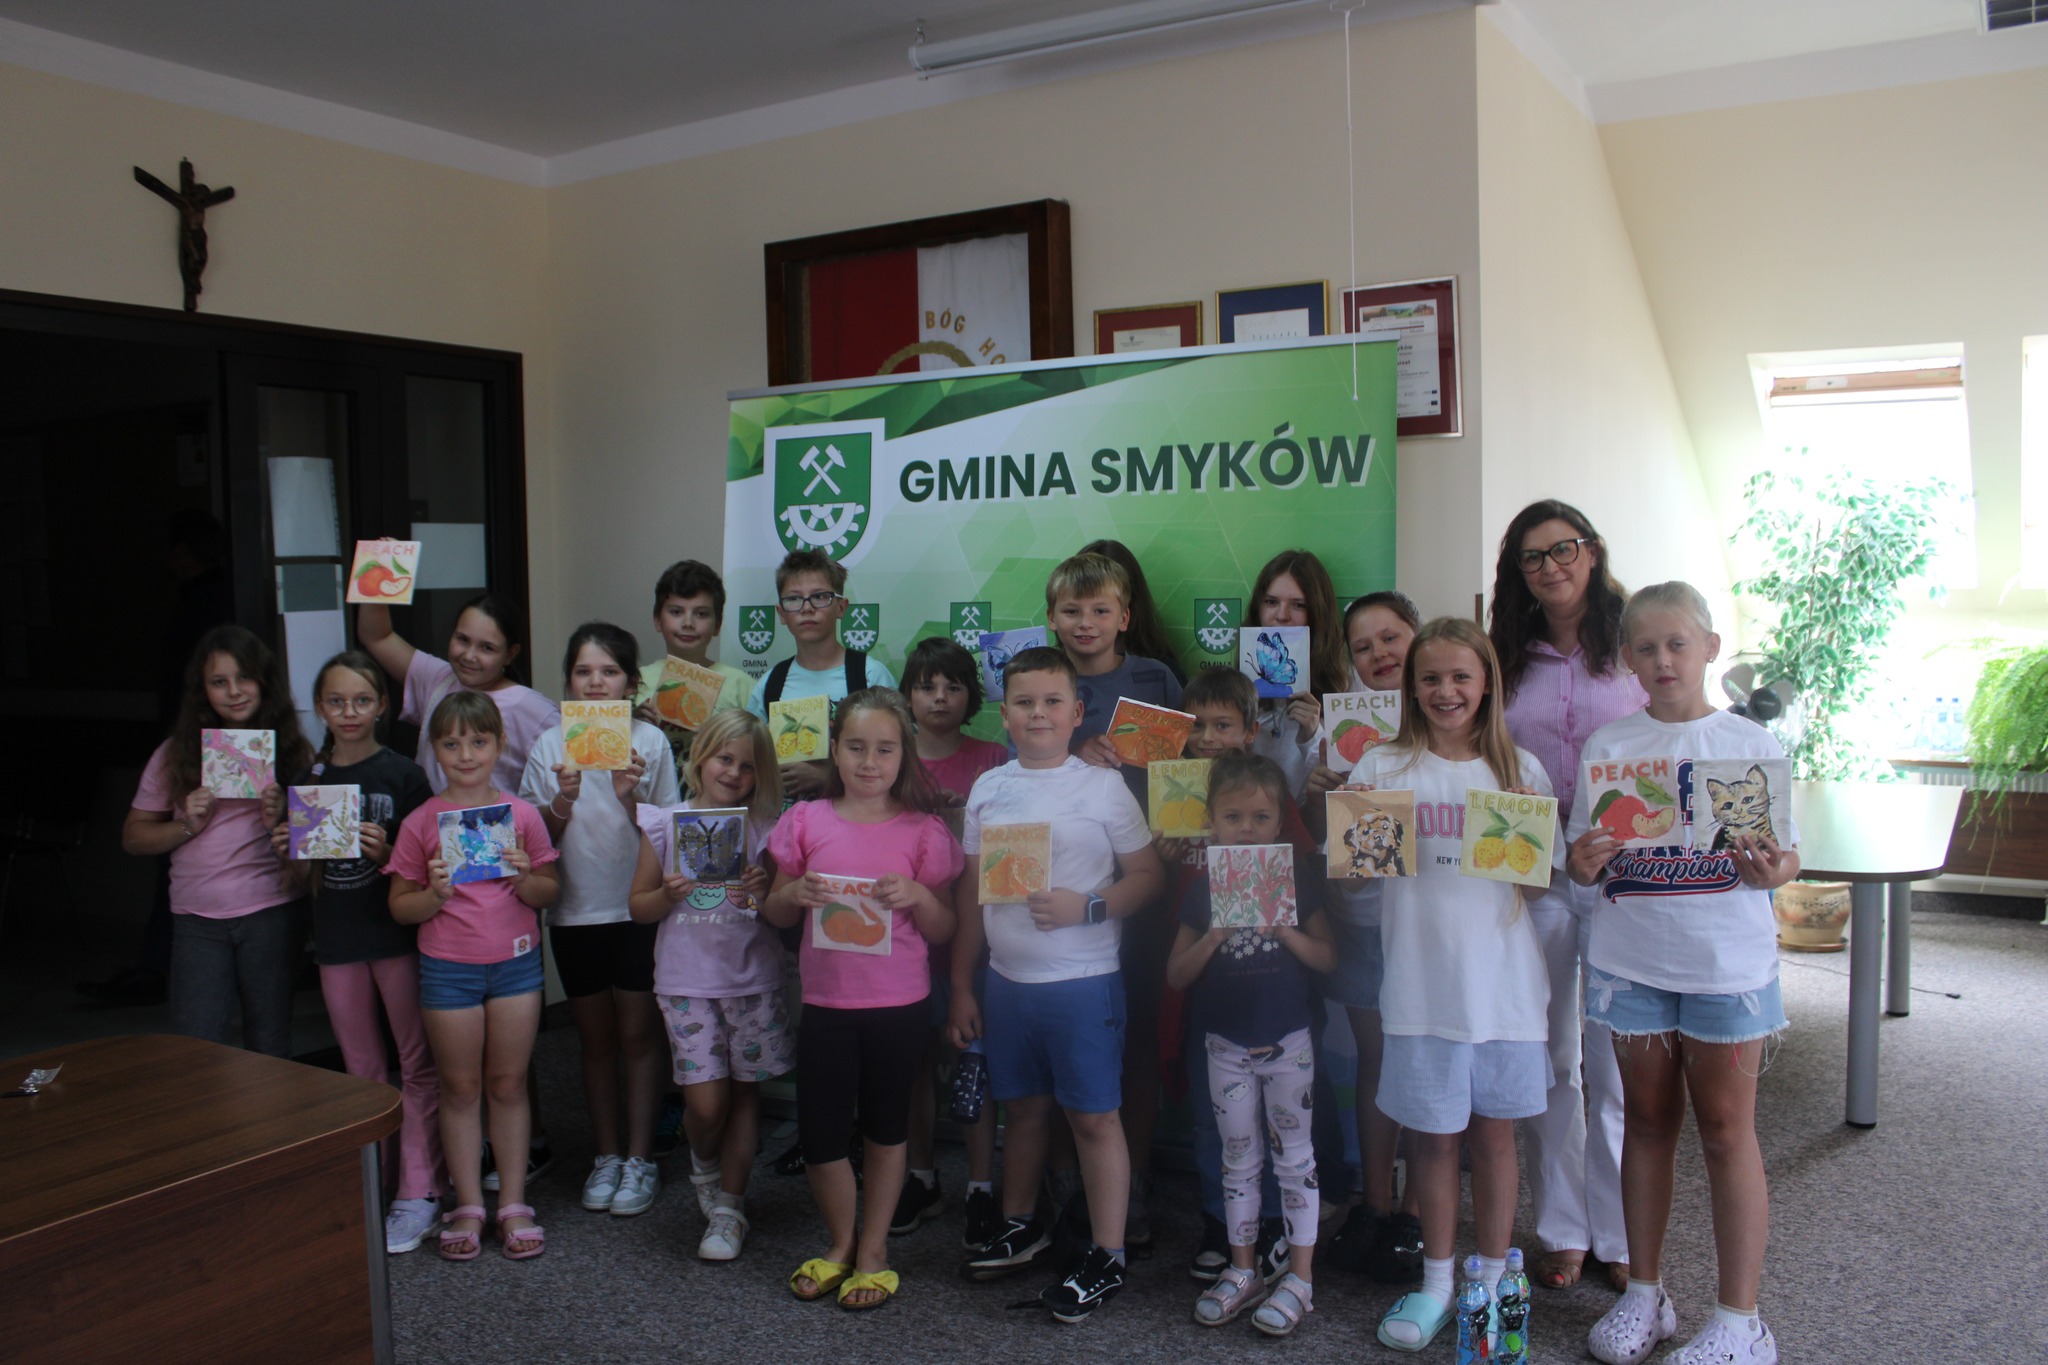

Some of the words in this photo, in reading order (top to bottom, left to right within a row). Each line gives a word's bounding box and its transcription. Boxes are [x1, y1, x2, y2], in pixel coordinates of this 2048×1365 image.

[925, 308, 965, 334] BÓG
[899, 451, 1077, 503] GMINA
[1091, 421, 1374, 495] SMYKÓW
[361, 544, 415, 556] PEACH
[742, 659, 768, 668] GMINA
[665, 659, 722, 689] ORANGE
[563, 704, 630, 718] ORANGE
[771, 698, 824, 717] LEMON
[1330, 694, 1397, 712] PEACH
[1120, 704, 1193, 732] ORANGE
[1590, 759, 1668, 784] PEACH
[1469, 792, 1551, 817] LEMON
[982, 825, 1049, 843] ORANGE
[1436, 855, 1453, 865] NEW
